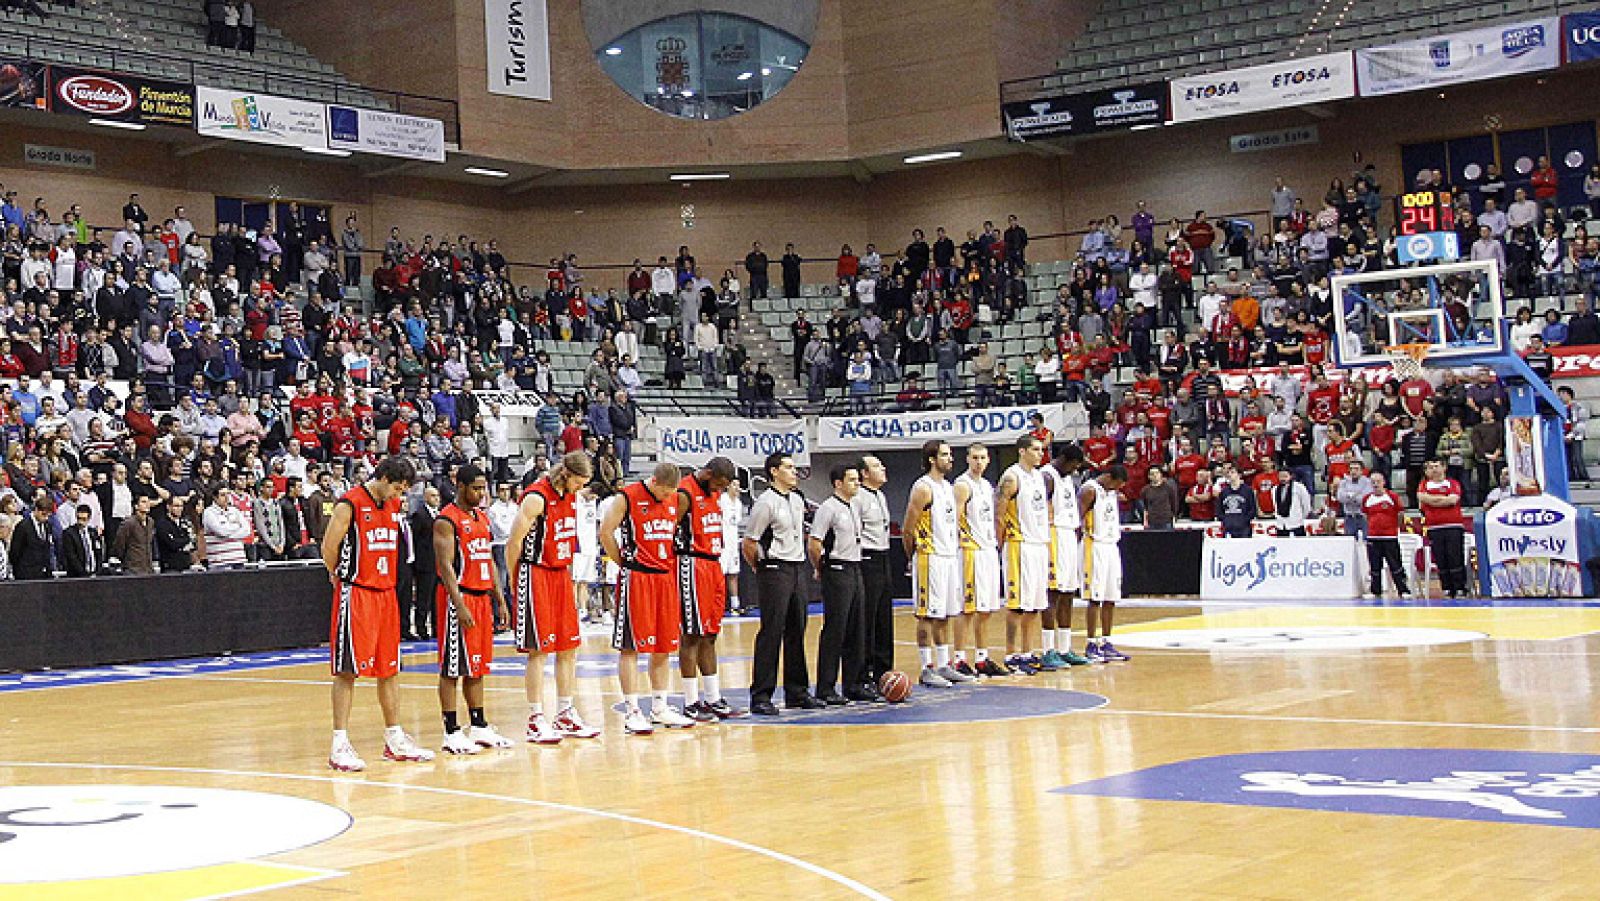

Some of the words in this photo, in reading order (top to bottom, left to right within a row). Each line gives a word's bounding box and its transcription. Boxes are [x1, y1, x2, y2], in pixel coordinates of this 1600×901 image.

[506, 1, 525, 86] Turism
[1272, 66, 1330, 88] ETOSA
[1185, 81, 1240, 100] ETOSA
[141, 100, 154, 112] de
[156, 102, 192, 116] Murcia
[1401, 208, 1437, 236] 24
[840, 418, 904, 438] AGUA
[909, 418, 953, 436] para
[662, 428, 713, 453] AGUA
[716, 435, 747, 453] para
[750, 431, 805, 455] TODOS
[1508, 511, 1555, 525] Hero
[1268, 557, 1345, 577] endesa
